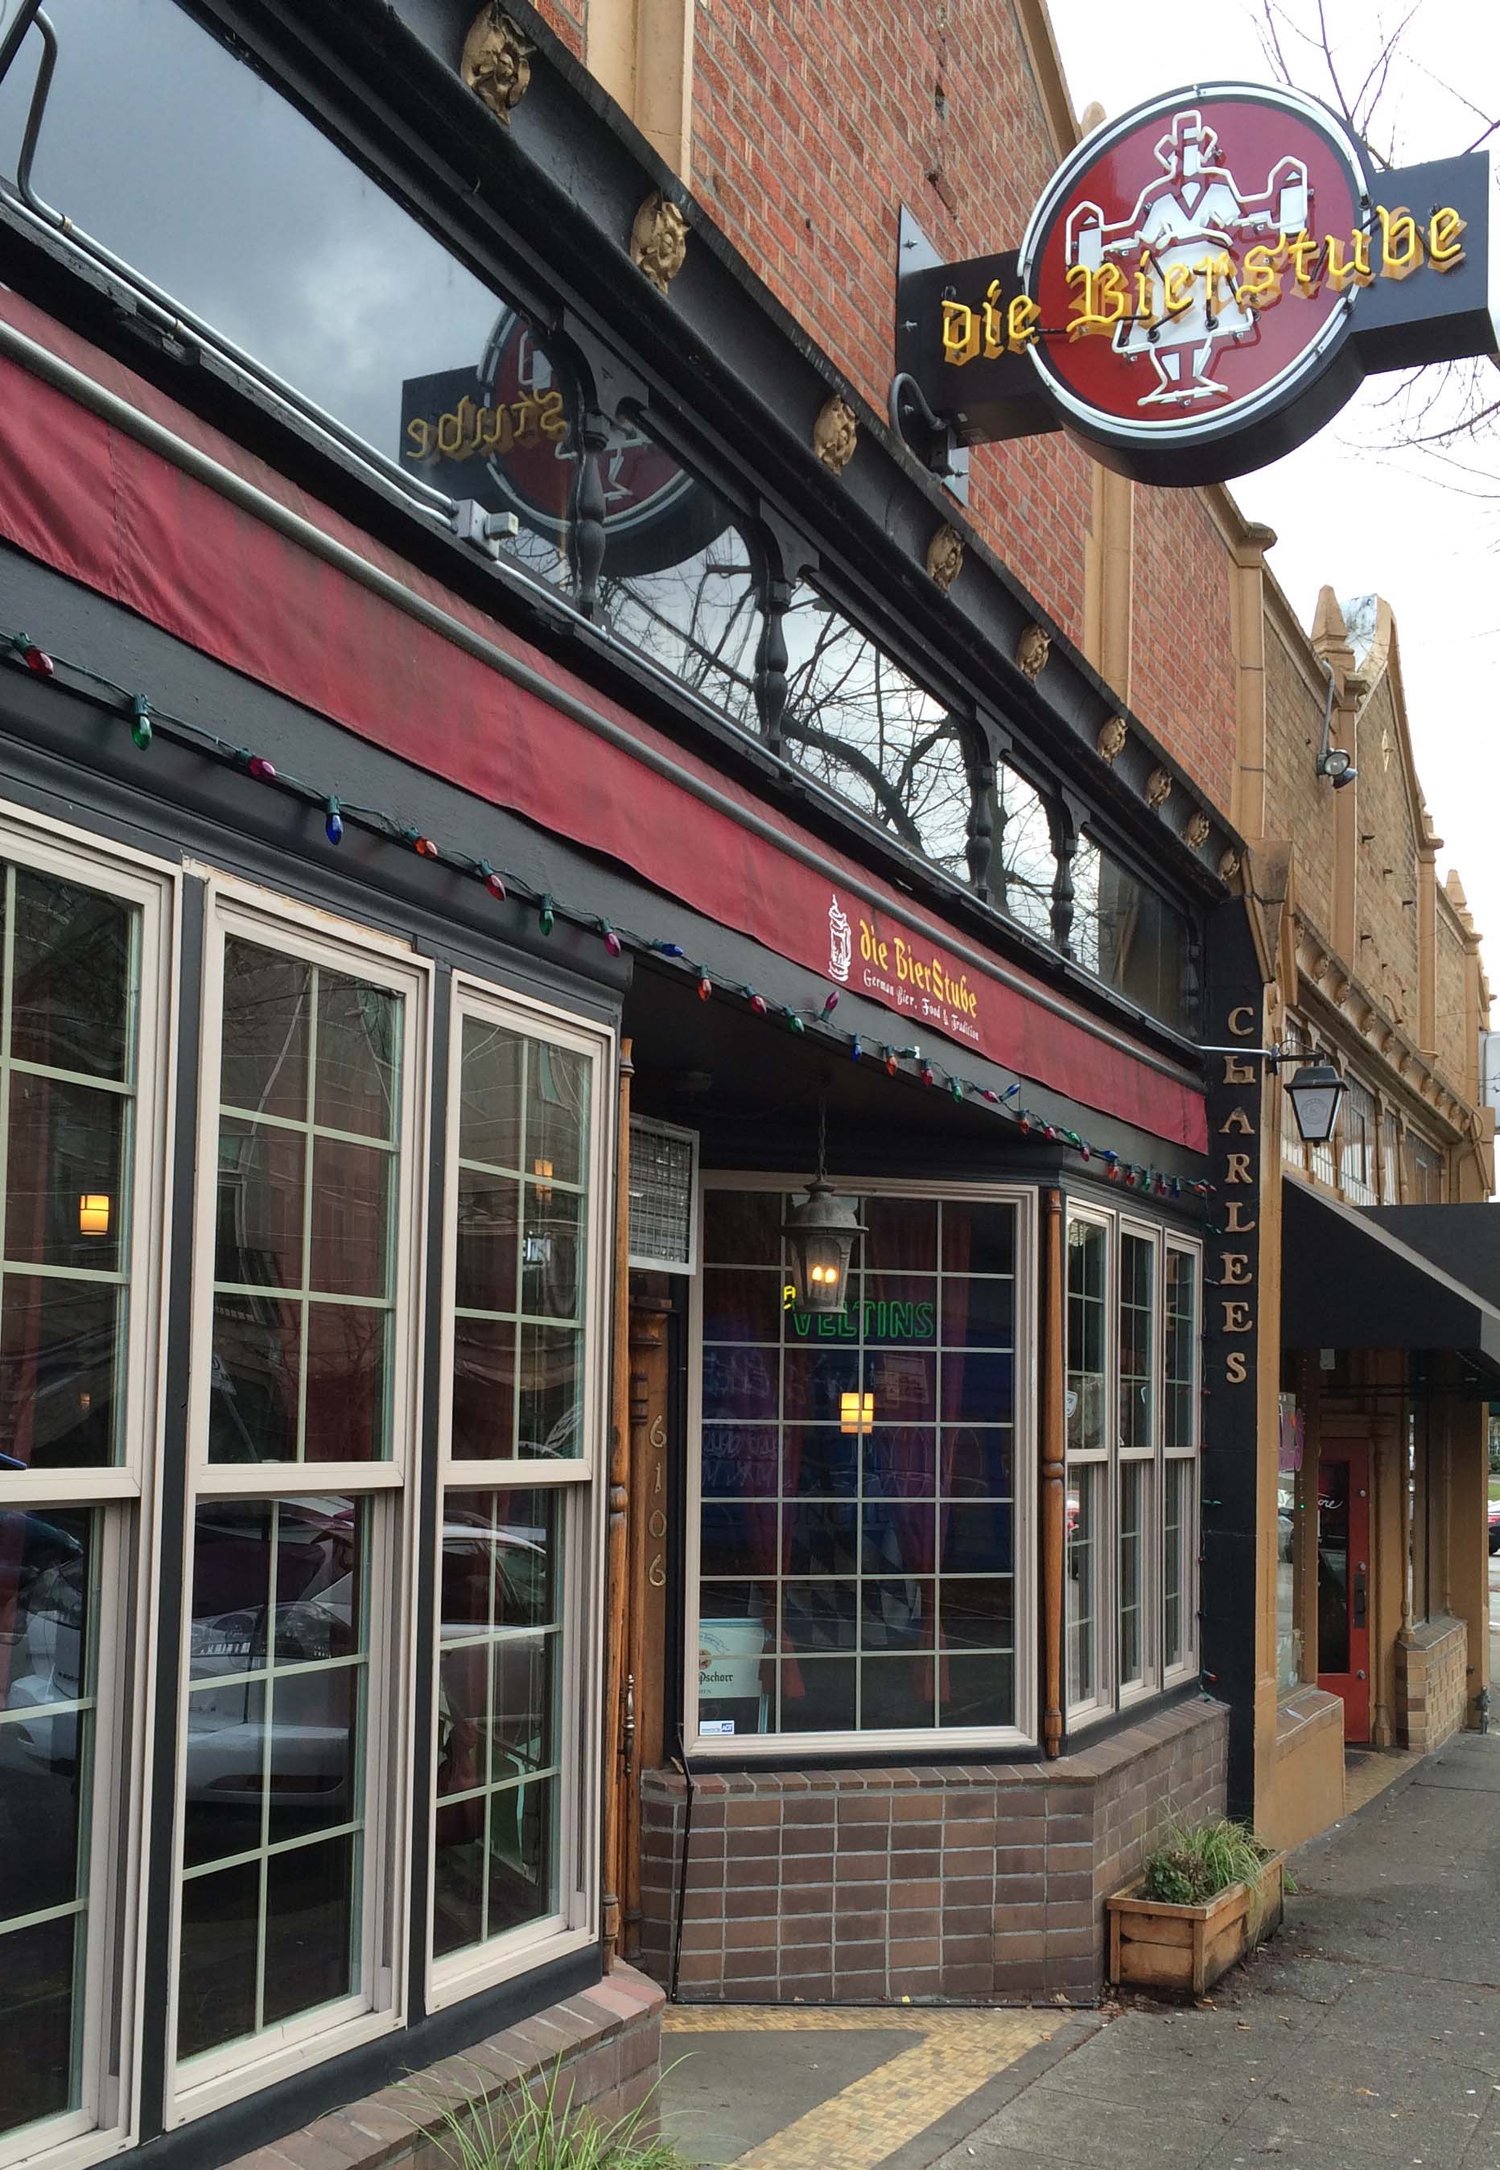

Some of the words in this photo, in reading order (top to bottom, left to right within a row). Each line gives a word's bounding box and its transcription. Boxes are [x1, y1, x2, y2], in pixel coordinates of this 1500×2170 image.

[940, 279, 1041, 366] die
[860, 919, 888, 972] die
[863, 968, 895, 996] German
[921, 997, 941, 1019] Food
[942, 1008, 950, 1026] &
[951, 1014, 980, 1041] Tradition
[791, 1299, 935, 1338] VELTINS
